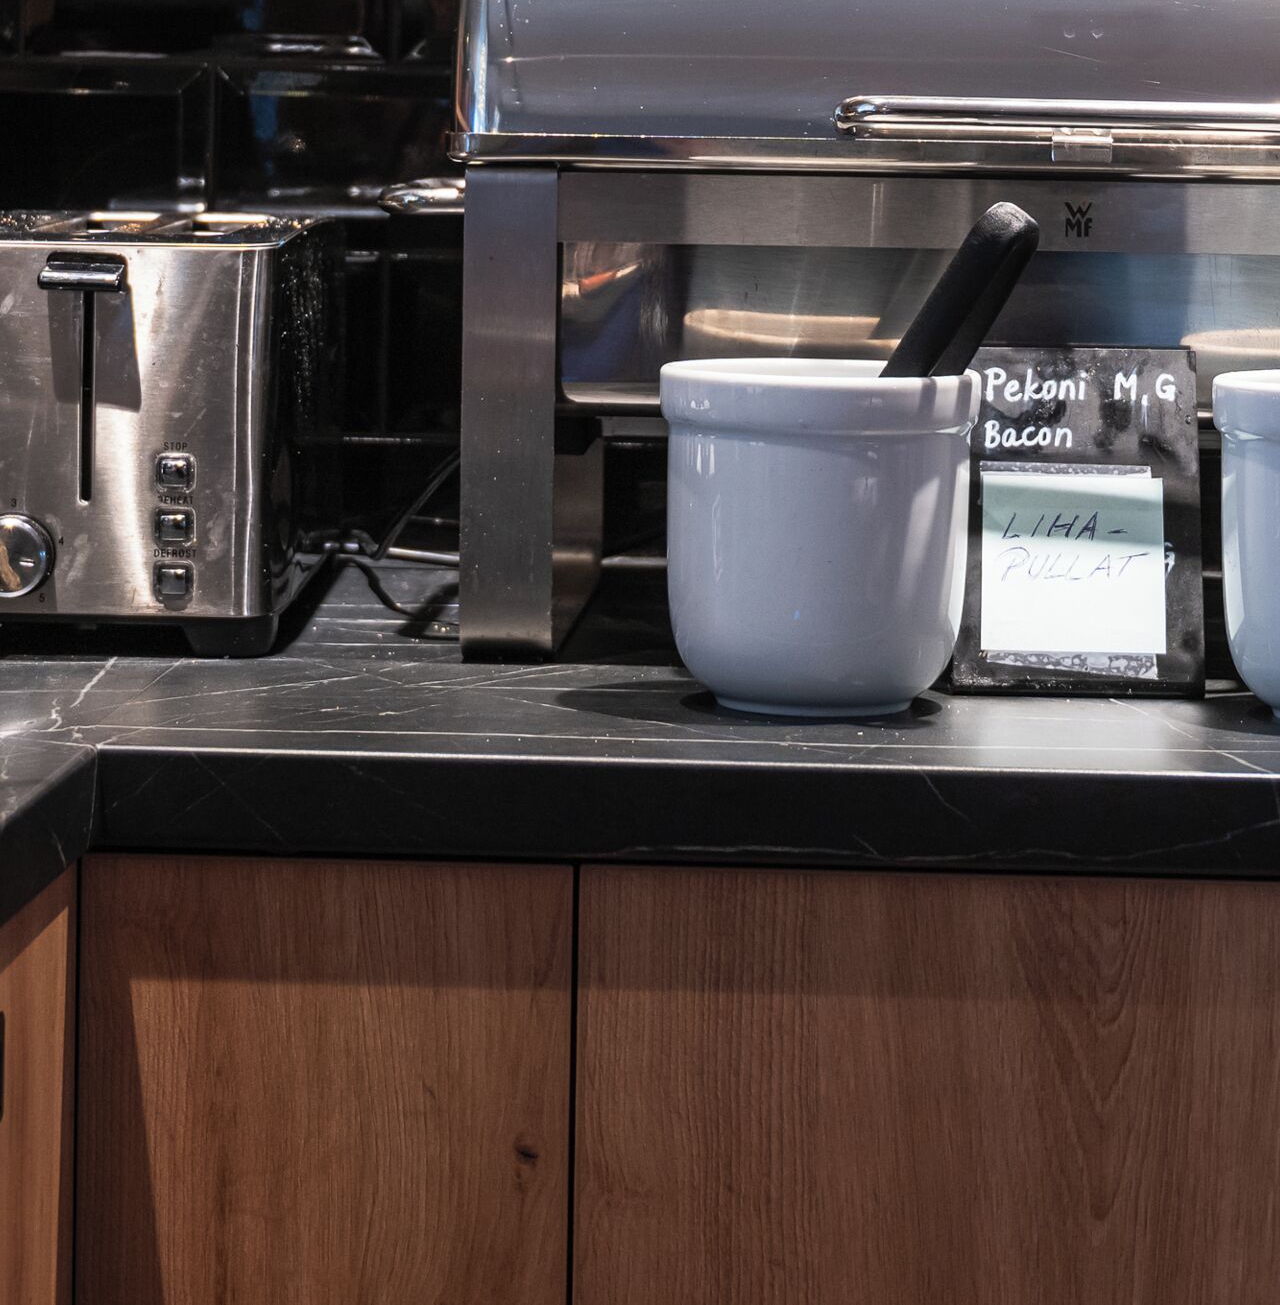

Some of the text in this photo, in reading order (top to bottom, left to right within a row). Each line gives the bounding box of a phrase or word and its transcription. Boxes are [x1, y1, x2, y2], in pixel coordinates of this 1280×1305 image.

[1064, 201, 1093, 238] WMF
[984, 366, 1087, 403] Pekoni
[984, 420, 1073, 449] Bacon
[163, 441, 188, 451] STOP
[10, 498, 17, 508] 3
[153, 548, 197, 558] DEFROST
[998, 546, 1151, 582] PULLAT
[39, 593, 46, 602] 5
